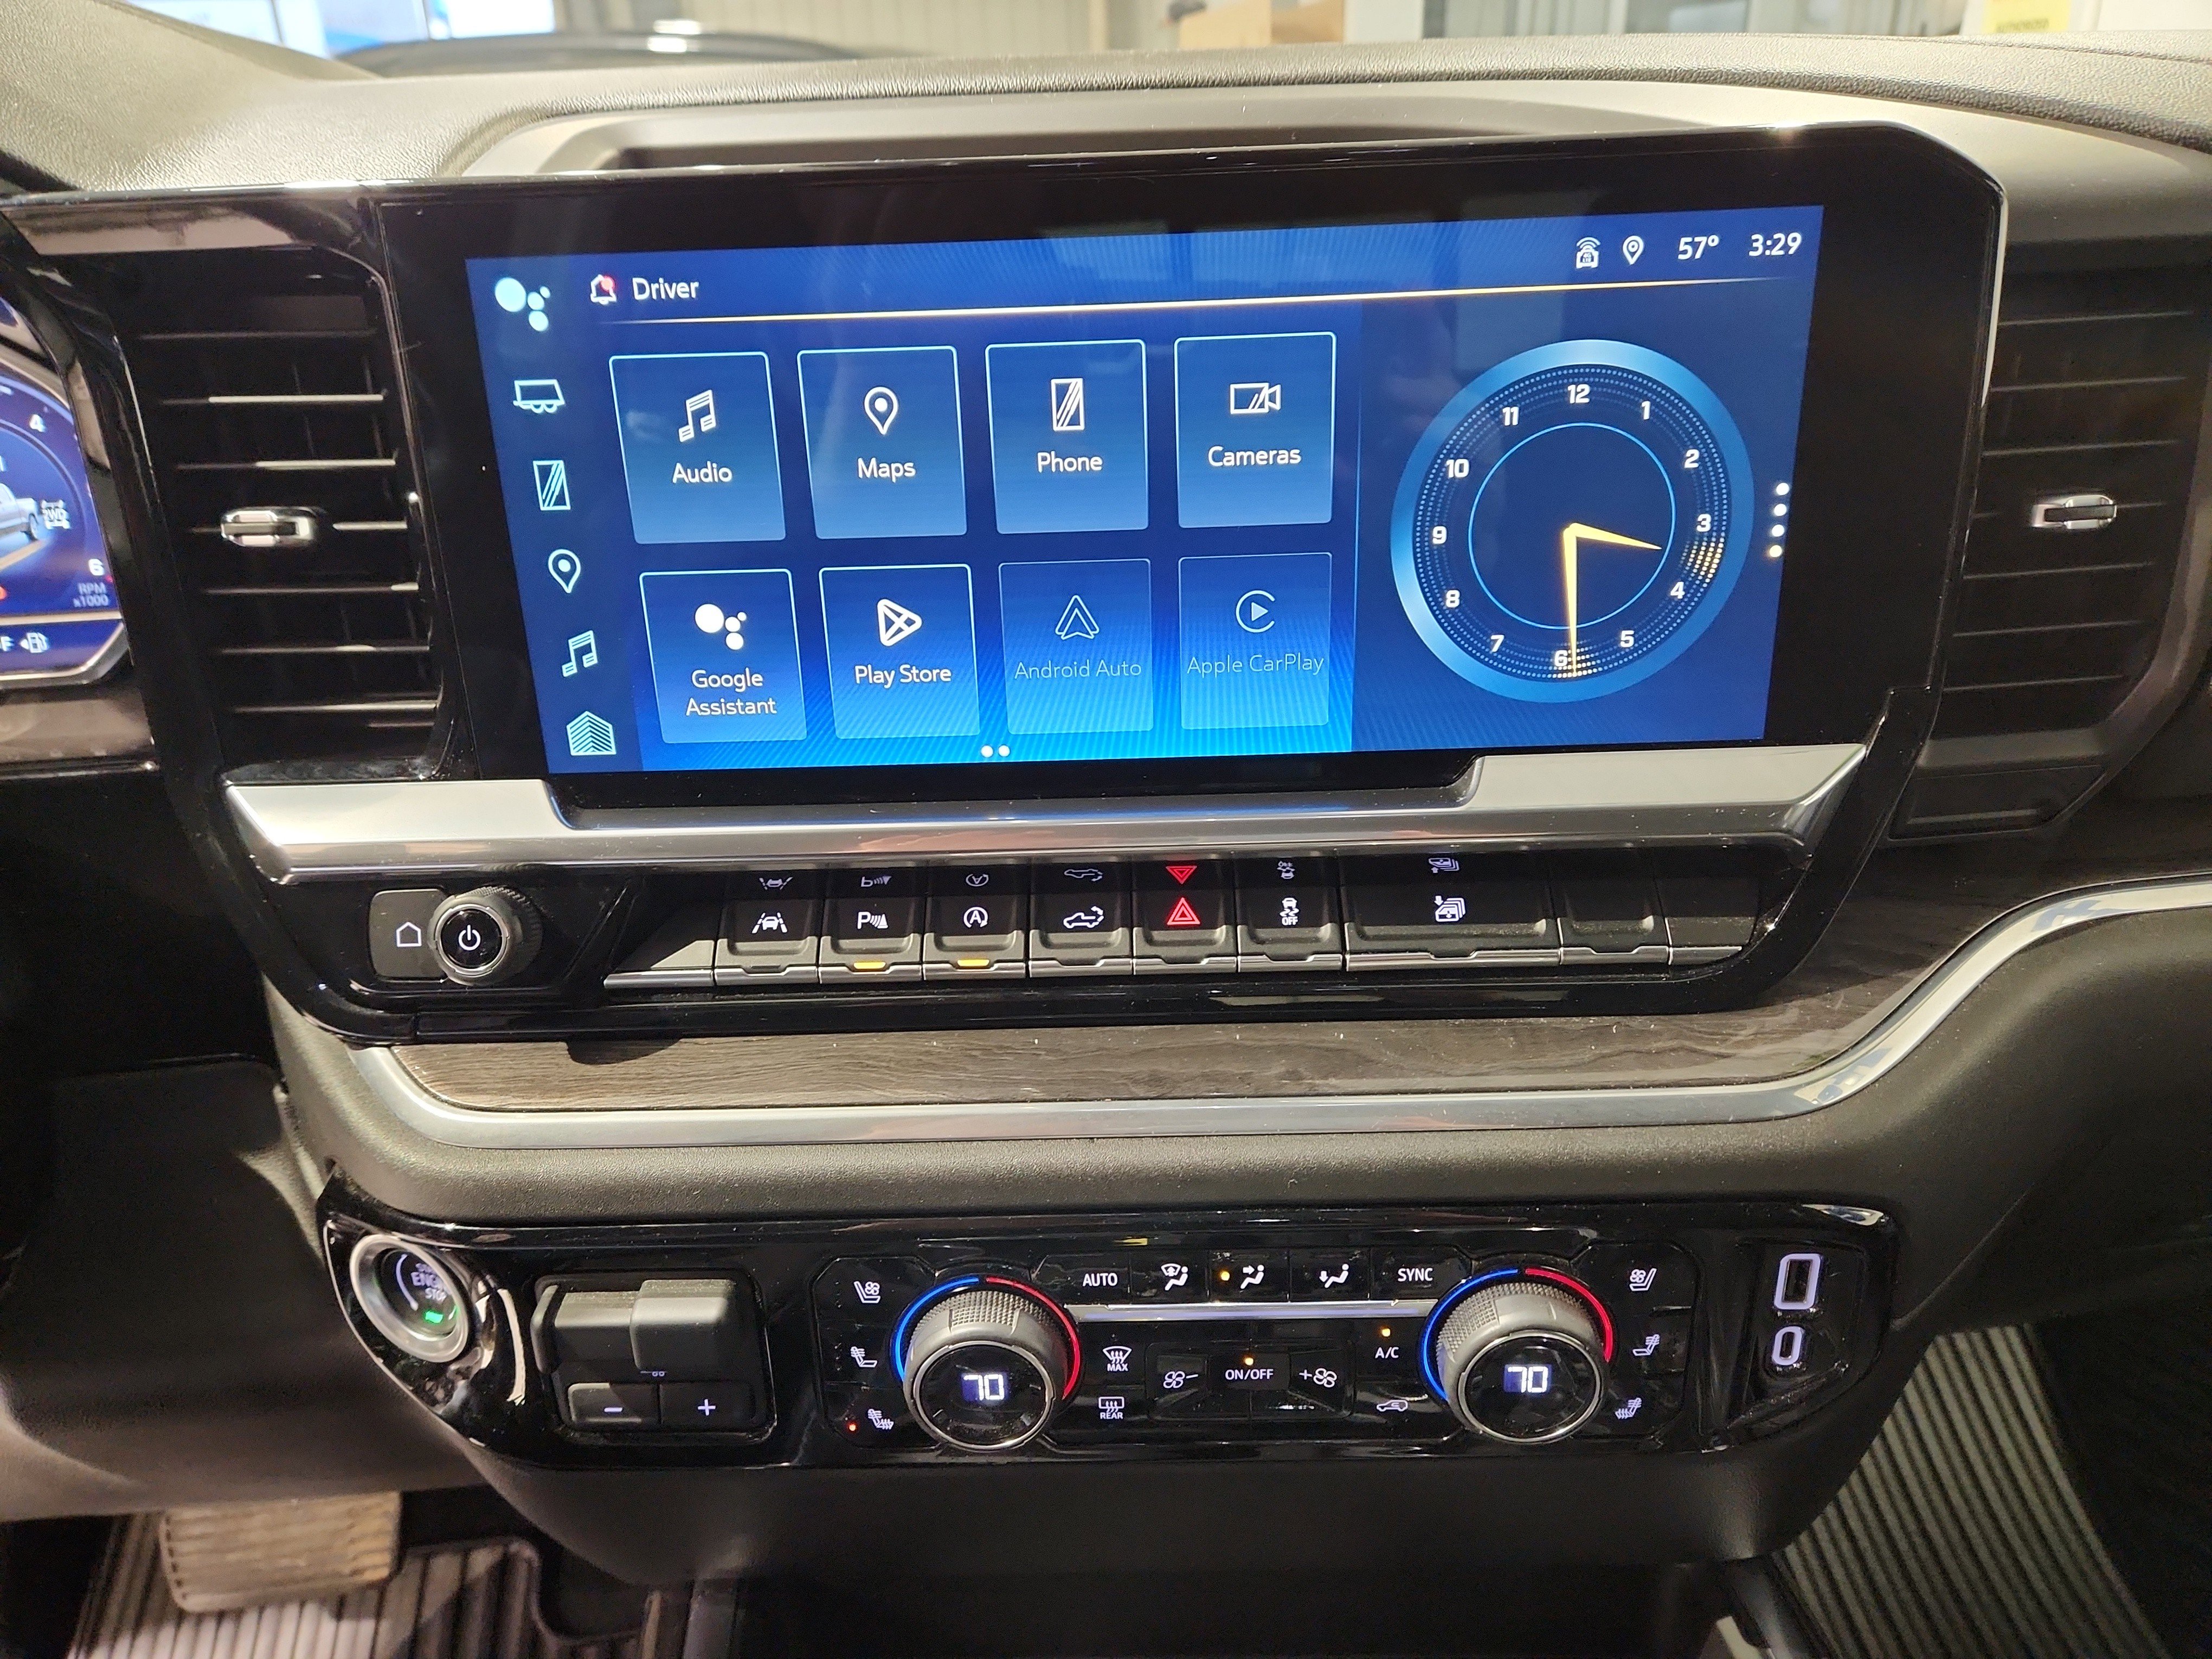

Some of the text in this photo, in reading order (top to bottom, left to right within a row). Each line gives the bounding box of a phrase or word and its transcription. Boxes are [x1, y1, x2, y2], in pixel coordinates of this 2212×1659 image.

[1748, 232, 1802, 256] 3:29
[632, 277, 699, 300] Driver
[1567, 384, 1590, 404] 12
[1502, 406, 1519, 426] 11
[1641, 401, 1651, 420] 1
[29, 414, 46, 433] 4
[1037, 451, 1103, 473] Phone
[1208, 446, 1301, 467] Cameras
[1684, 449, 1700, 468] 2
[672, 460, 732, 484] Audio
[858, 457, 916, 483] Maps
[1445, 459, 1469, 478] 10
[1696, 513, 1712, 532] 3
[1432, 526, 1447, 544] 9
[88, 558, 105, 576] 6
[78, 582, 107, 594] RPM
[1670, 581, 1685, 599] 4
[1445, 589, 1460, 608] 8
[1, 635, 14, 652] F
[1490, 634, 1504, 652] 7
[1620, 630, 1635, 648] 5
[1187, 652, 1324, 678] Apple CarPlay
[1553, 650, 1568, 667] 6
[855, 664, 951, 689] Play Store
[1014, 659, 1141, 679] Android Auto
[692, 667, 763, 692] Google
[686, 698, 777, 716] Assistant
[1282, 916, 1298, 926] OFF
[1082, 1272, 1118, 1287] AUTO
[1397, 1268, 1433, 1282] SYNC
[1375, 1347, 1399, 1359] A/C
[1107, 1362, 1128, 1372] MAX
[1225, 1368, 1274, 1380] ON/OFF
[963, 1372, 1005, 1401] 70
[1507, 1365, 1548, 1393] 70
[1099, 1411, 1123, 1419] REAR
